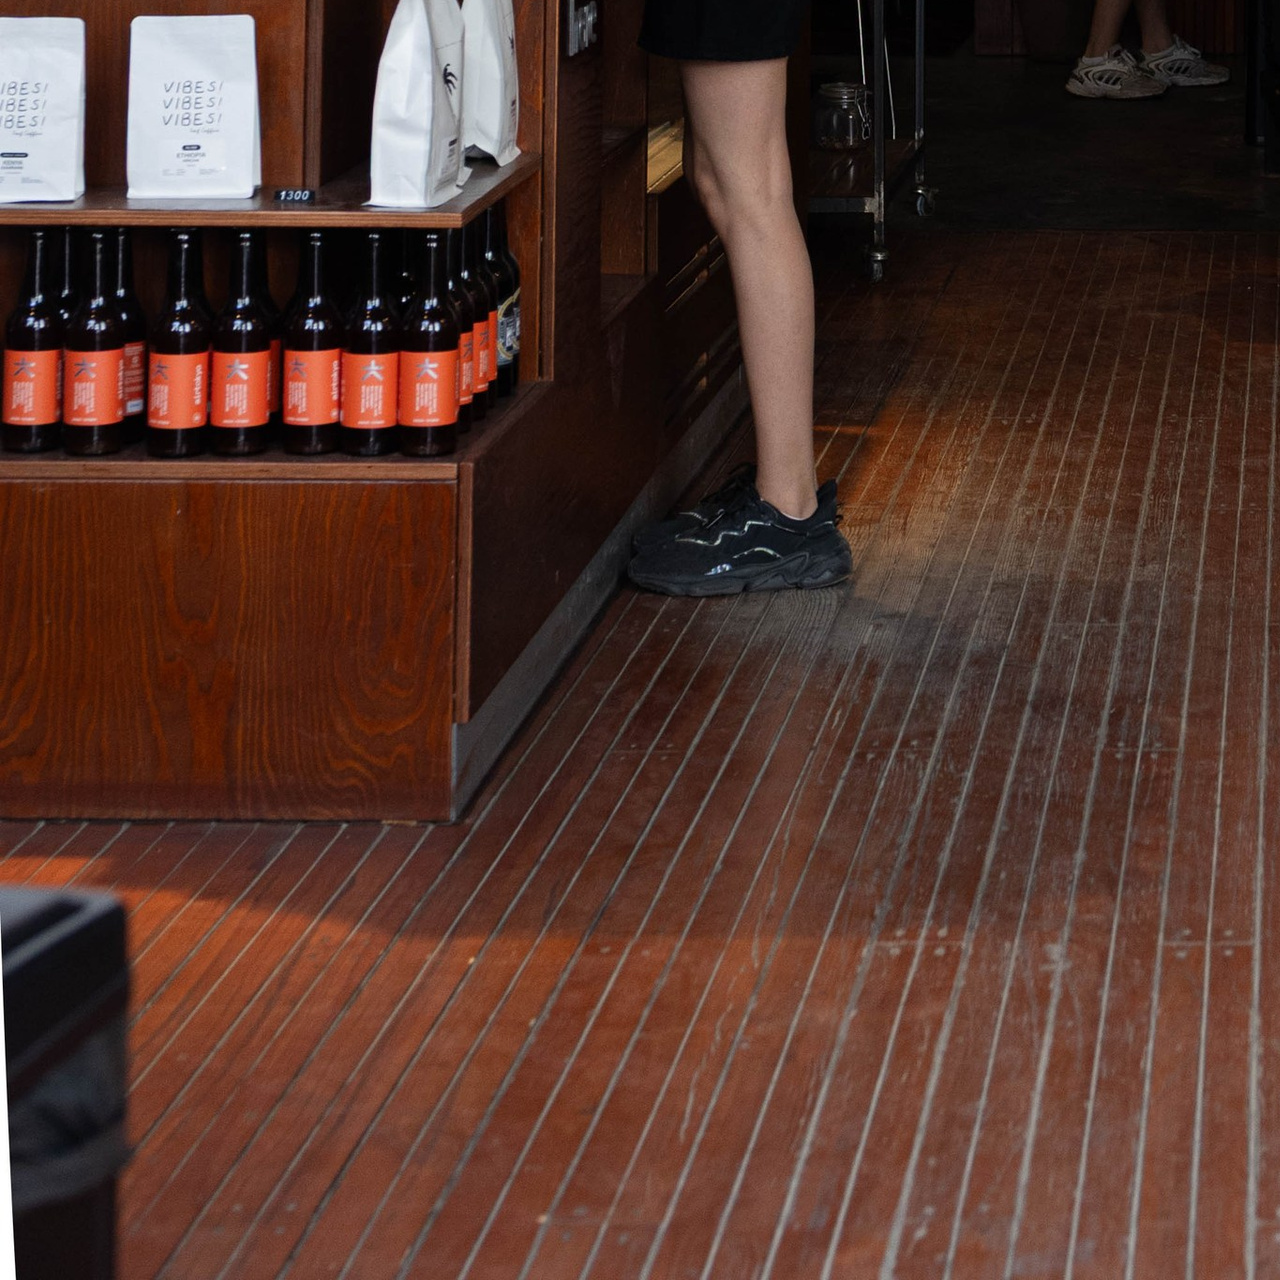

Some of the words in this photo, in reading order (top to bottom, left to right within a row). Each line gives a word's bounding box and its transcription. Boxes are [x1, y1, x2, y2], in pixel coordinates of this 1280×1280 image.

[0, 81, 48, 96] IBES!
[164, 81, 223, 94] VIBES!
[163, 96, 223, 110] VIBES!
[162, 112, 222, 126] VIBES!
[280, 190, 310, 200] 1300
